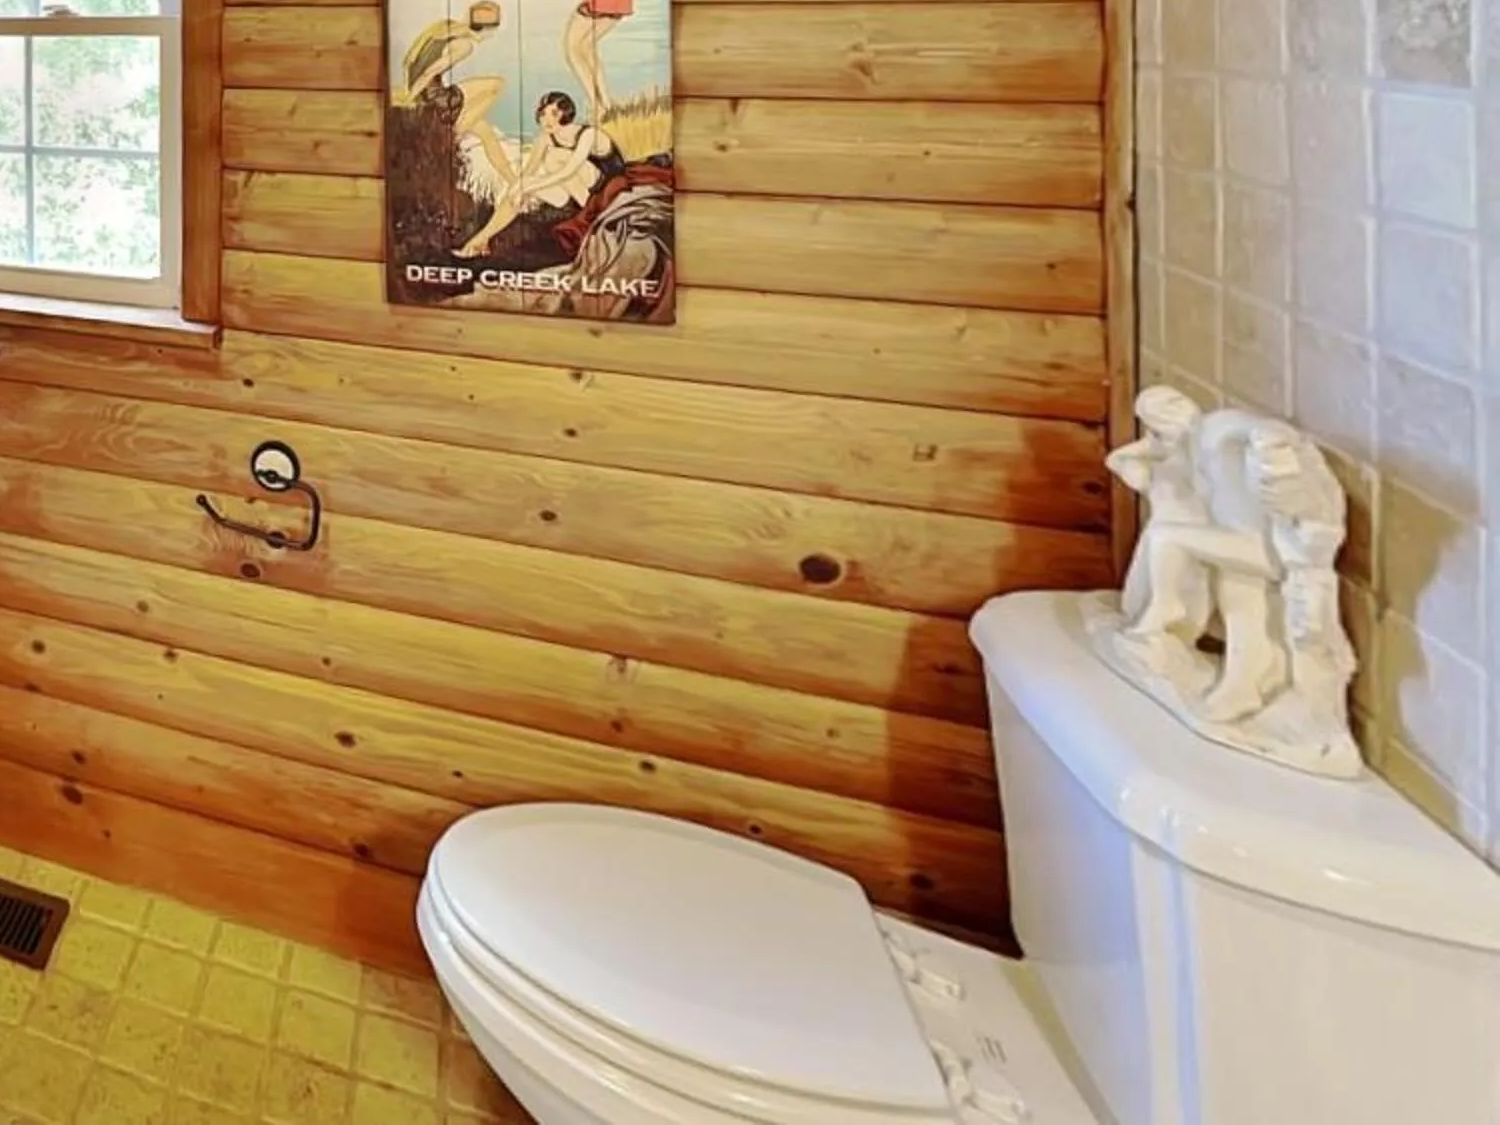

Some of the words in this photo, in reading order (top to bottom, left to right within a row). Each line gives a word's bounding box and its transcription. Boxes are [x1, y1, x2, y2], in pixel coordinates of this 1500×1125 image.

[405, 265, 474, 285] DEEP
[479, 270, 574, 293] CREEK
[581, 276, 661, 298] LAKE
